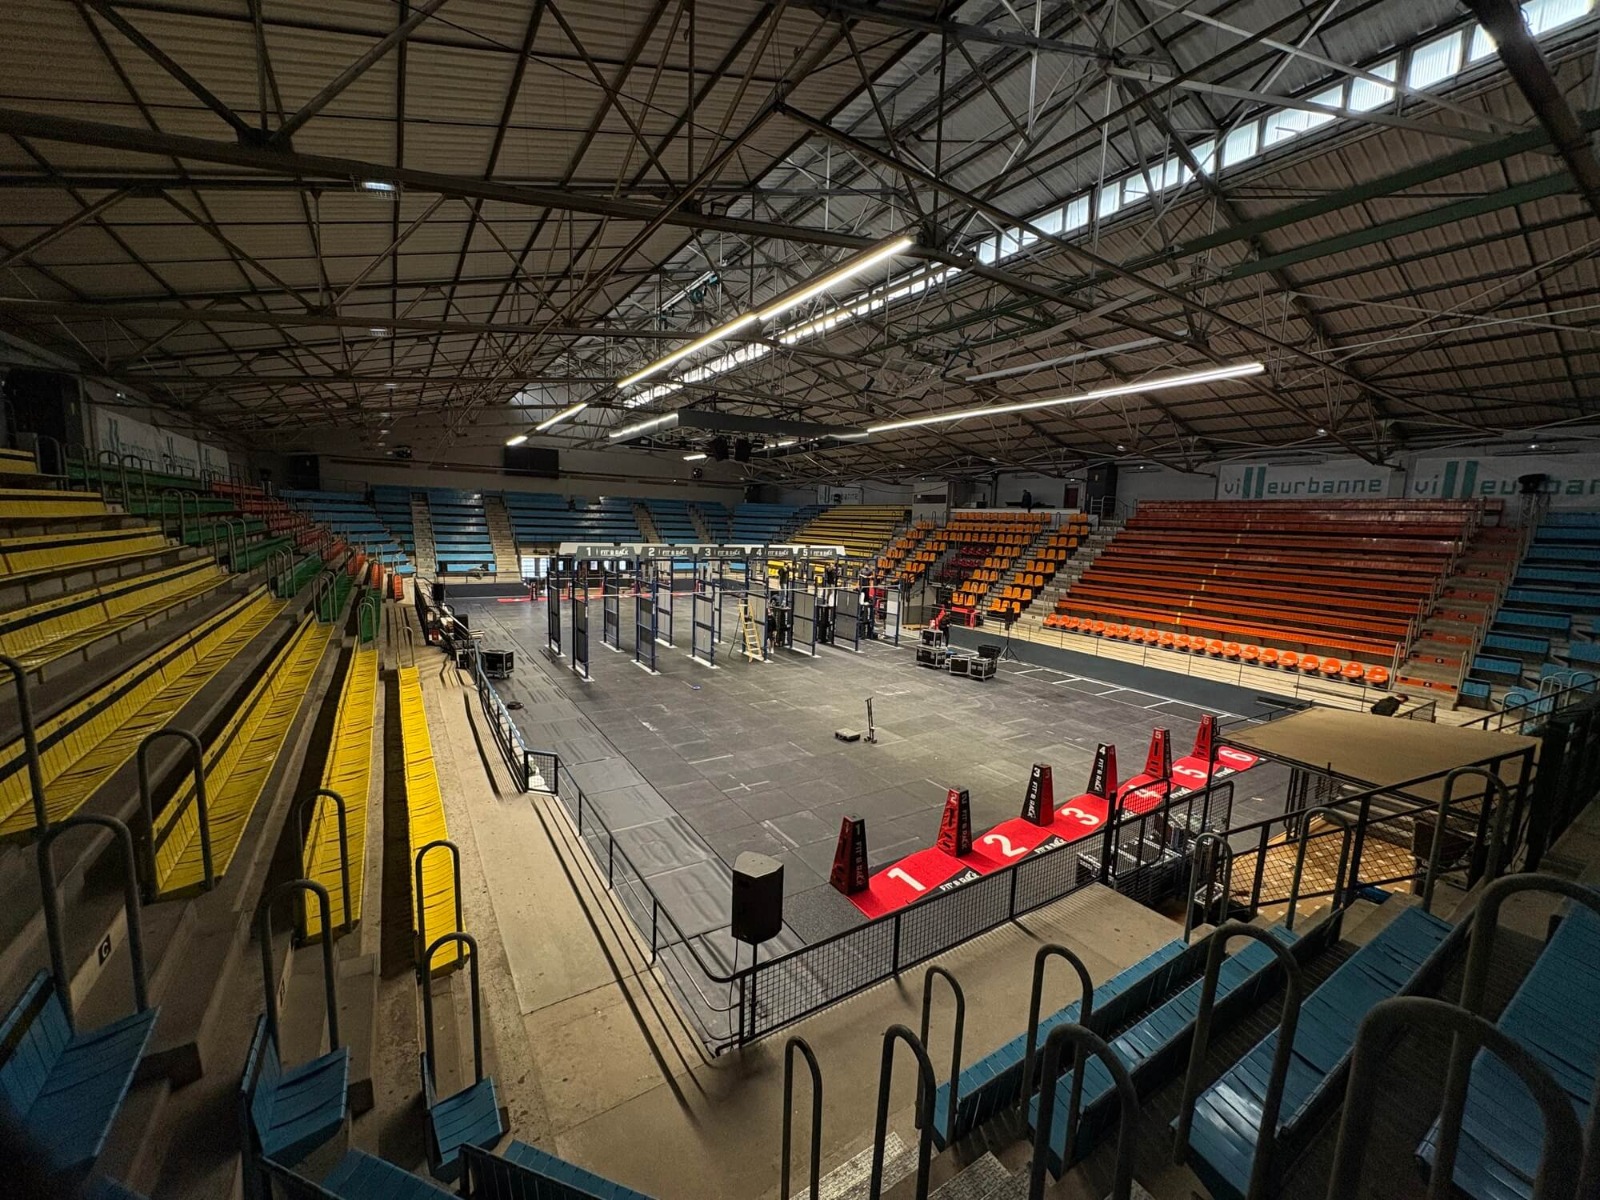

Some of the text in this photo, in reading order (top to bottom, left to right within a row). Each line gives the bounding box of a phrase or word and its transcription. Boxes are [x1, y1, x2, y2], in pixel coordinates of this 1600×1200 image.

[1224, 466, 1382, 499] villeurbanne
[586, 546, 591, 557] 1
[648, 547, 655, 557] 2
[704, 547, 711, 557] 3
[756, 548, 762, 557] 4
[802, 548, 809, 557] 5
[1202, 716, 1209, 725] 6
[1154, 731, 1161, 739] 5
[1099, 746, 1106, 755] 4
[1219, 750, 1252, 762] 6
[1033, 767, 1040, 778] 3
[1172, 765, 1207, 779] 5
[950, 793, 957, 805] 2
[961, 793, 967, 804] 2
[1061, 807, 1100, 826] 3
[855, 823, 860, 836] 1
[983, 834, 1028, 857] 2
[887, 867, 926, 892] 1
